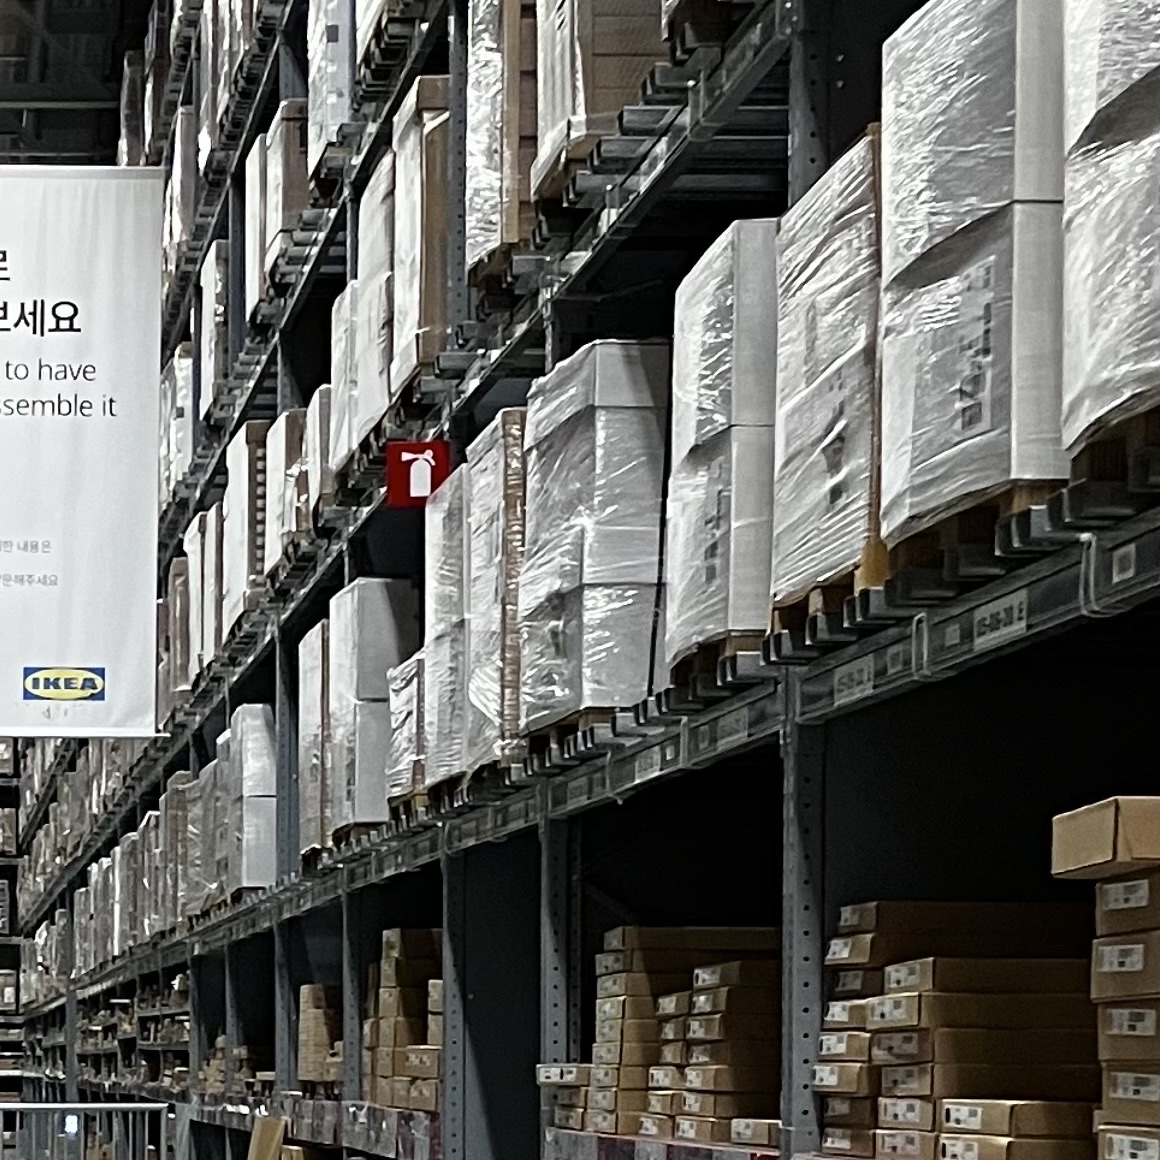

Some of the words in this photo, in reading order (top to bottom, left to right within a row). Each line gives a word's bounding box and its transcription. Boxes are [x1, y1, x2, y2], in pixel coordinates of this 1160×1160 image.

[4, 361, 30, 381] to
[38, 357, 97, 382] have
[102, 393, 118, 417] it
[32, 677, 98, 690] IKEA
